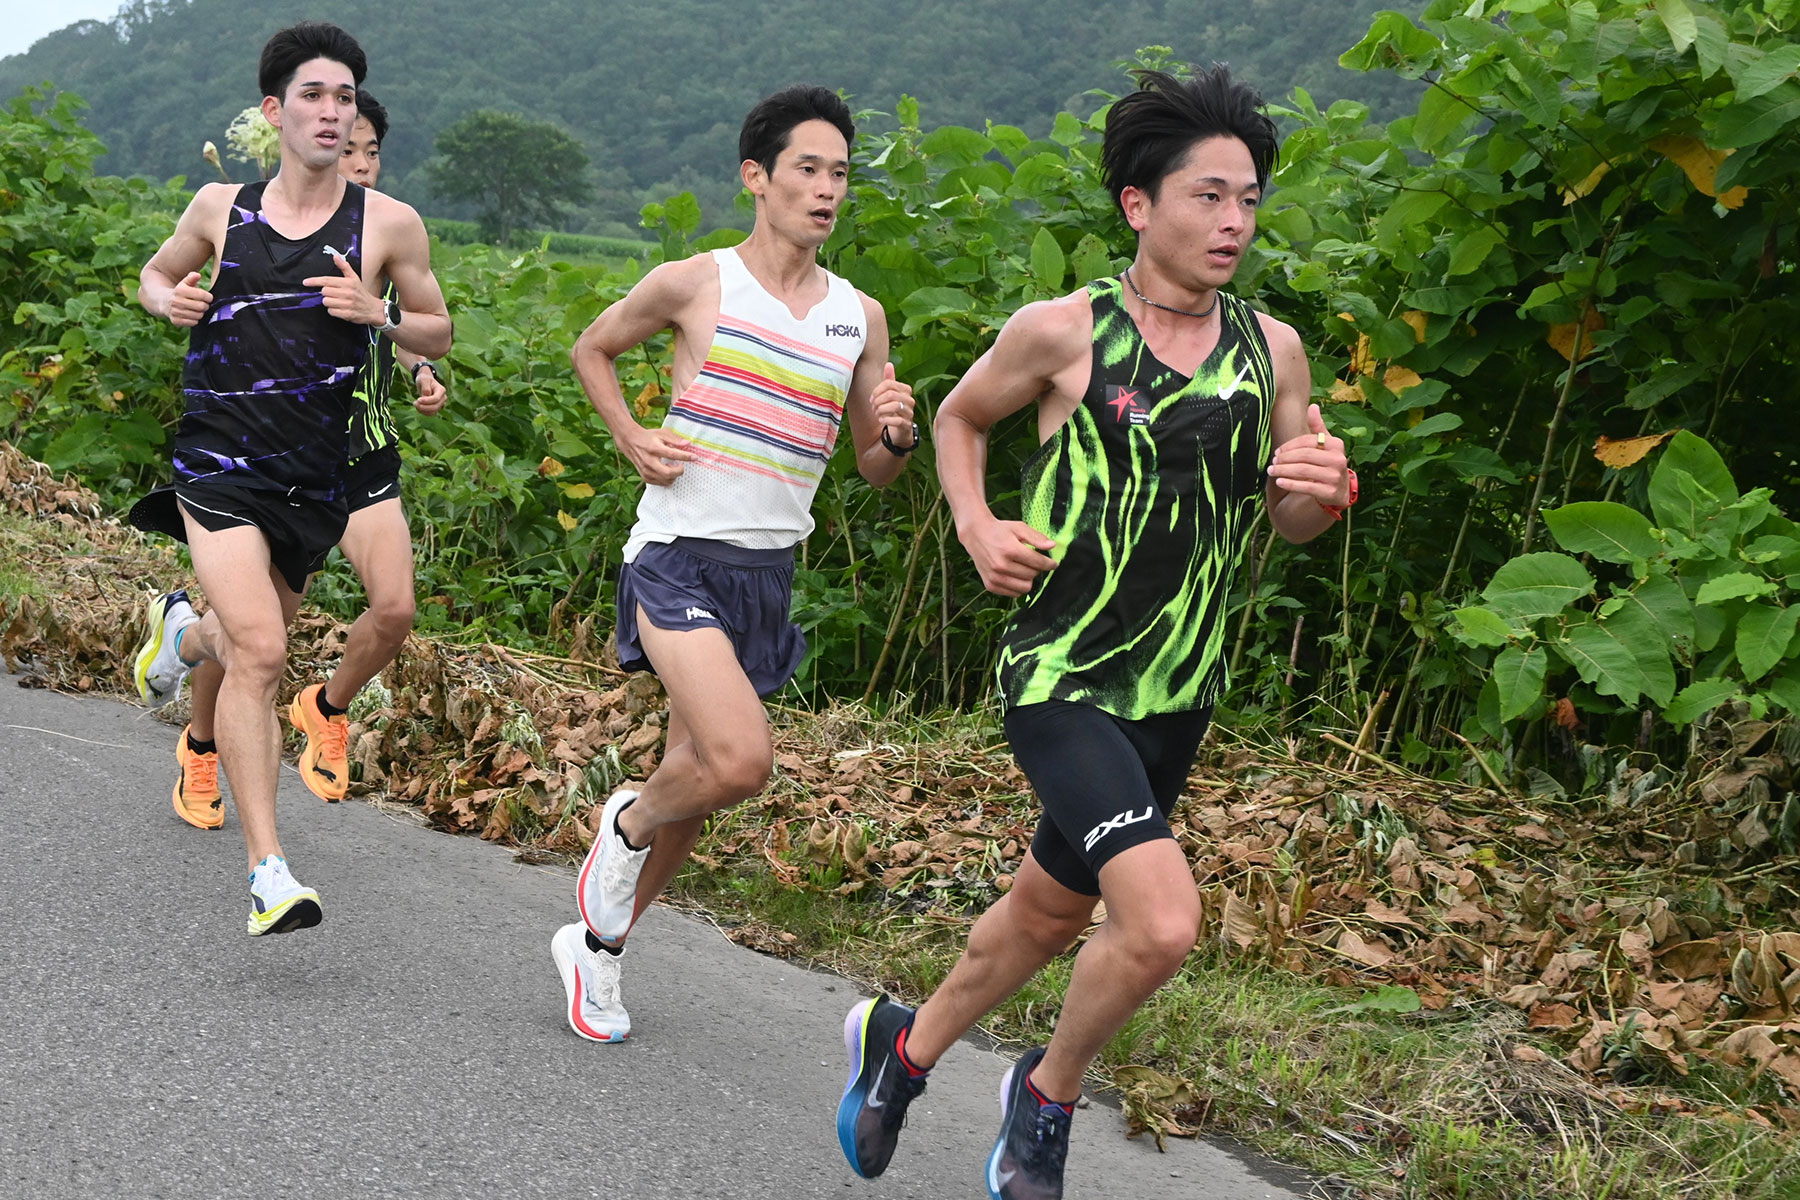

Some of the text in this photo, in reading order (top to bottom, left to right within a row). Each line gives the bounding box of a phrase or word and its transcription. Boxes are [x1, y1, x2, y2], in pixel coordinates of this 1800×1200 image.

[826, 324, 861, 339] HOKA
[1130, 412, 1150, 420] Running
[1084, 806, 1153, 852] 2XU
